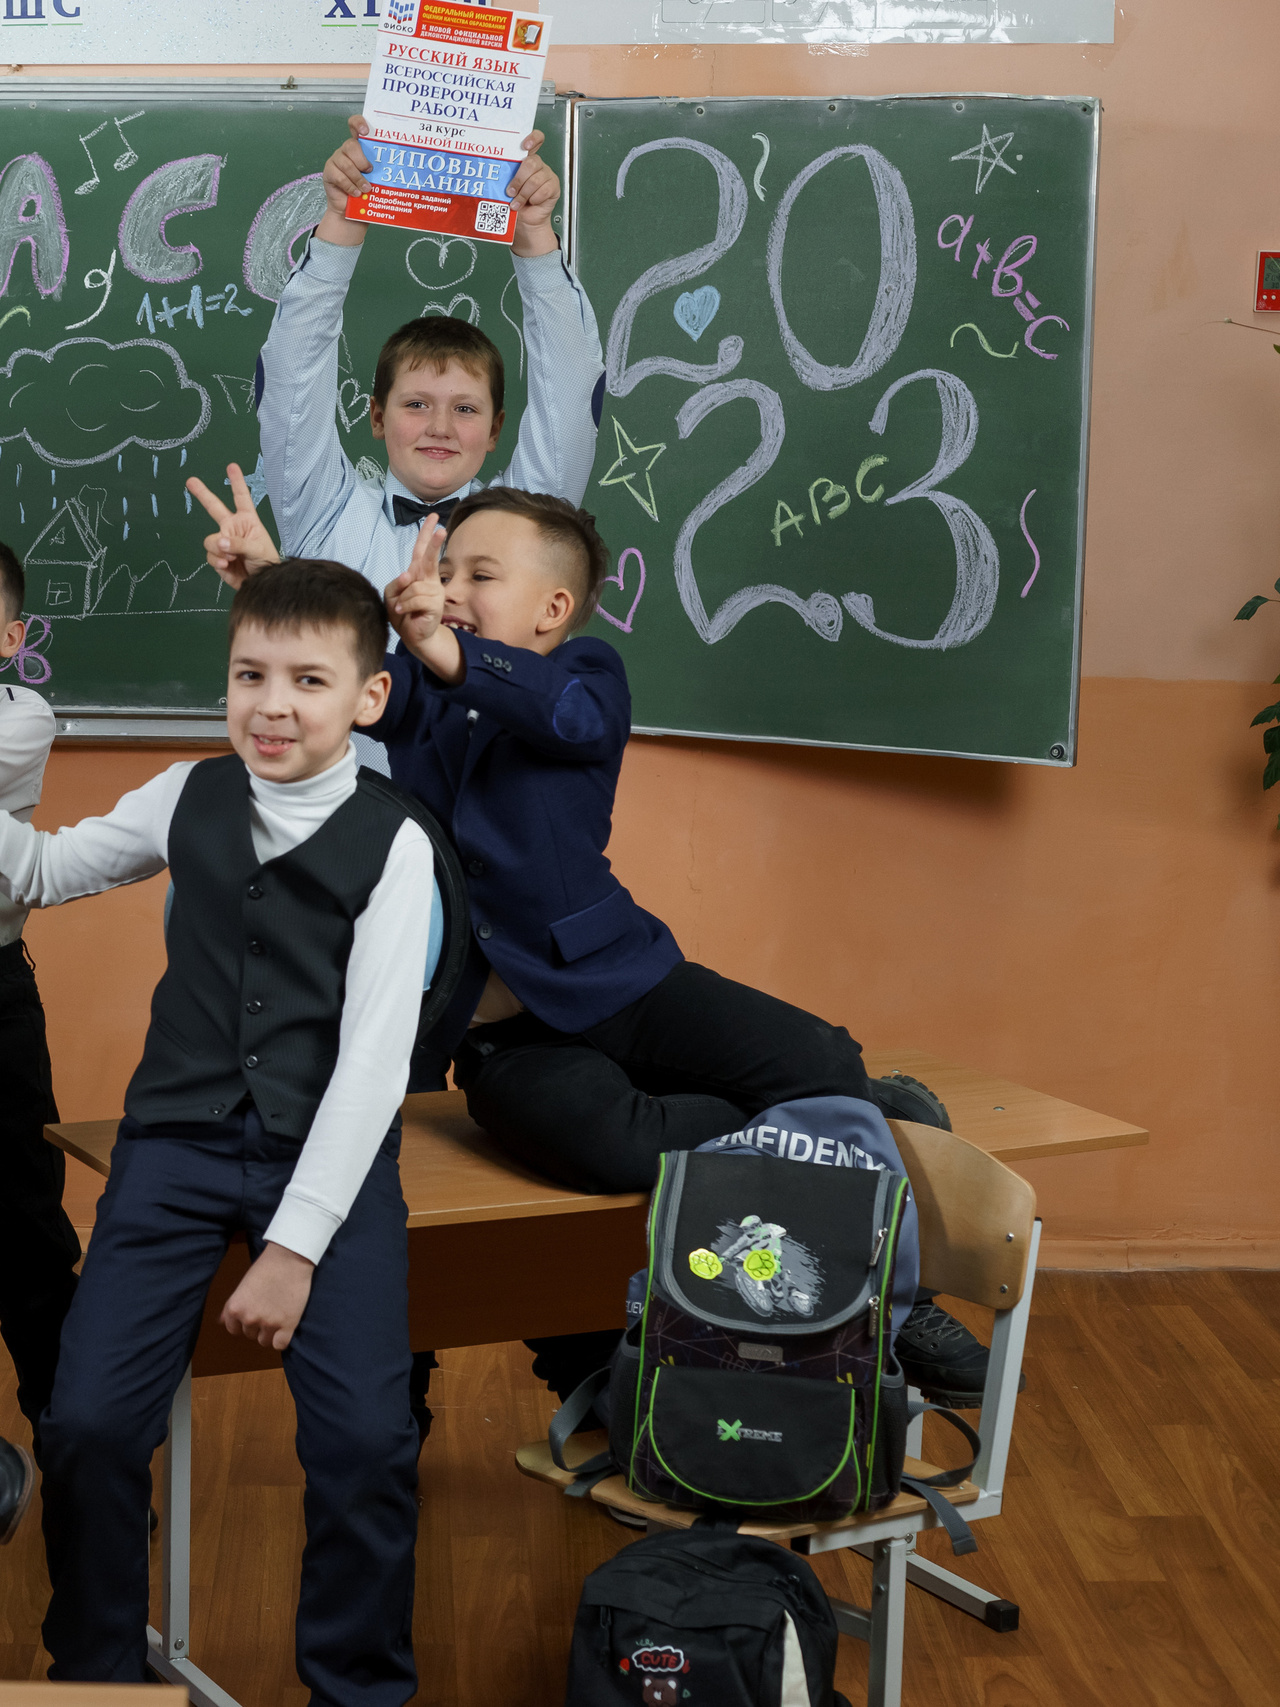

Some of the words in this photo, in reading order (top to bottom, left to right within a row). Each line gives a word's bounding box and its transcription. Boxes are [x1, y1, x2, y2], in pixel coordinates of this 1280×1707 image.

[423, 4, 474, 18] ФЕДЕРАЛЬНЫЙ
[475, 11, 508, 23] ИНСТИТУТ
[443, 16, 469, 25] КАЧЕСТВА
[469, 20, 506, 30] ОБРАЗОВАНИЯ
[384, 22, 414, 33] ФИОКО
[429, 25, 452, 34] НОВОЙ
[454, 29, 504, 41] ОФИЦИАЛЬНОЙ
[420, 30, 481, 45] ДЕМОНСТРАЦИОННОЙ
[481, 39, 503, 48] ВЕРСИИ
[388, 43, 468, 67] РУССКИЙ
[472, 57, 520, 75] ЯЗЫК
[384, 62, 516, 93] ВСЕРОССИЙСКАЯ
[381, 77, 513, 110] ПРОВЕРОЧНАЯ
[410, 99, 479, 122] РАБОТА
[419, 122, 432, 132] за
[436, 126, 466, 138] курс
[374, 128, 451, 148] НАЧАЛЬНОЙ
[454, 141, 504, 156] ШКОЛЫ
[373, 145, 501, 181] ТИПОВЫЕ
[381, 166, 485, 196] ЗАДАНИЯ
[369, 194, 412, 207] Подробные
[413, 203, 448, 213] критерии
[380, 189, 420, 200] вариантов
[421, 194, 452, 204] заданий
[367, 210, 395, 220] Ответы
[368, 202, 412, 213] оценивания
[605, 136, 918, 398] 20
[136, 283, 254, 335] 1+1=2
[673, 368, 1000, 651] 23
[716, 1418, 783, 1443] EXTREME
[641, 1651, 678, 1669] CUTE
